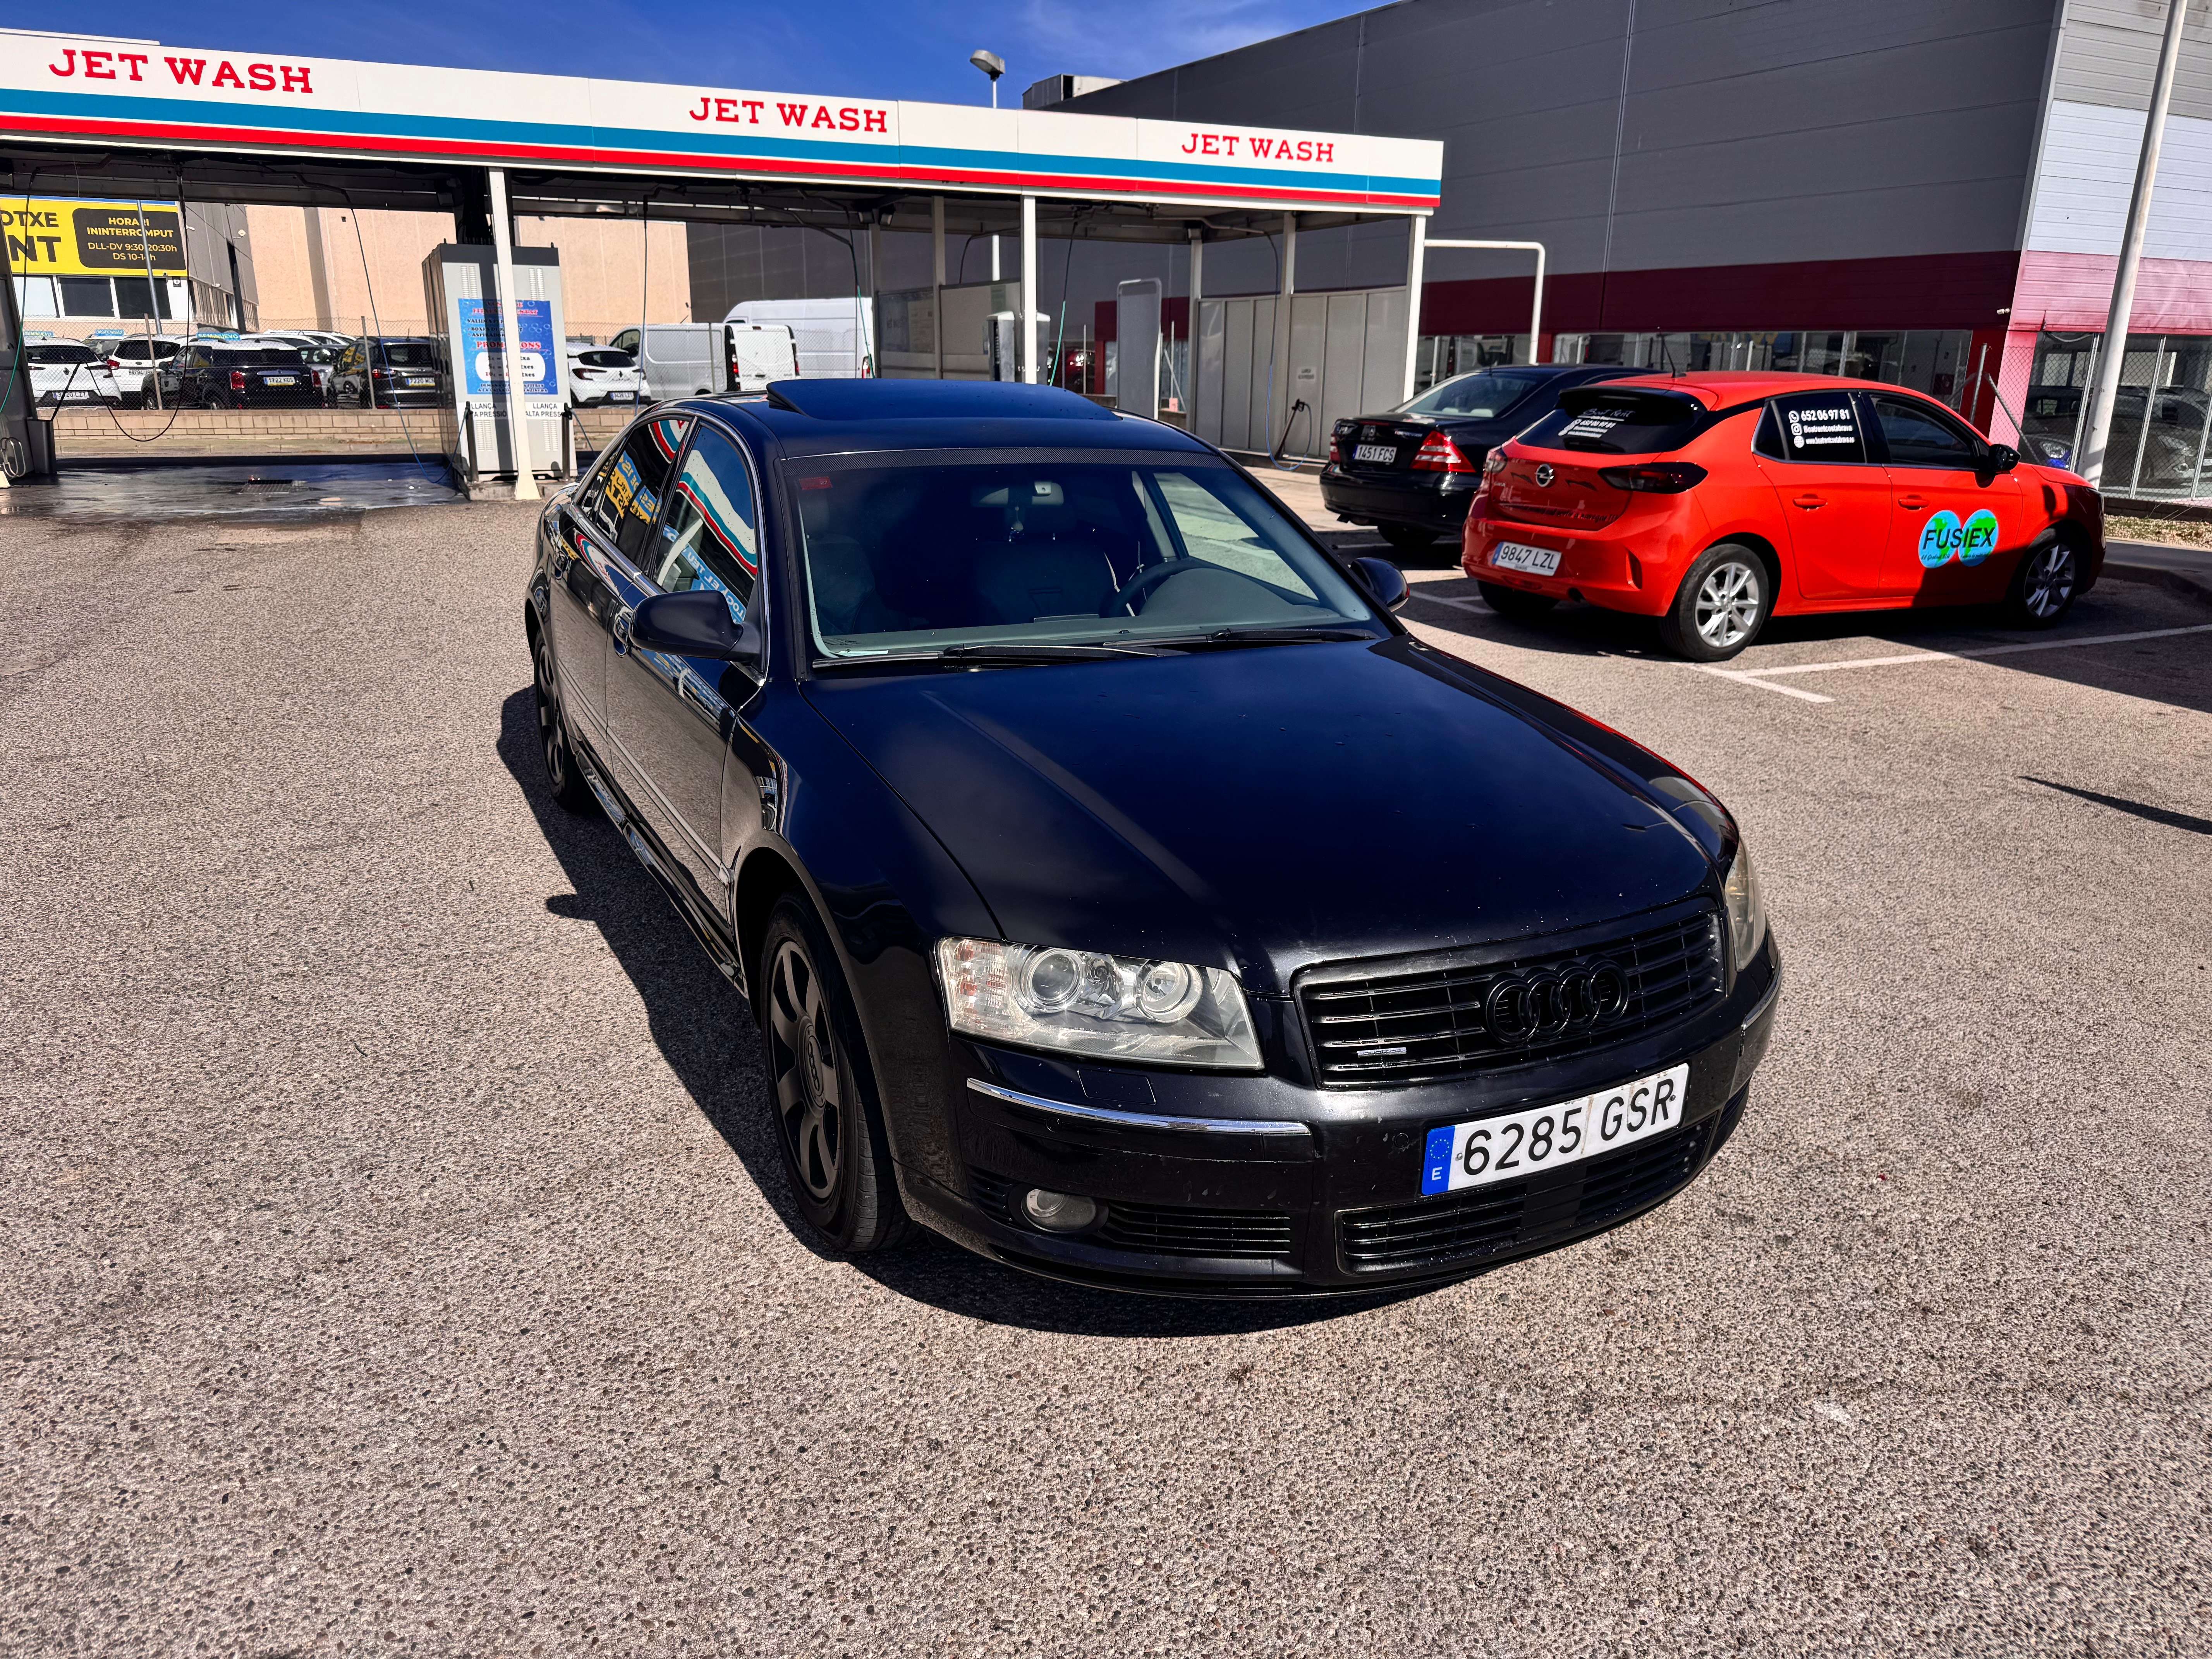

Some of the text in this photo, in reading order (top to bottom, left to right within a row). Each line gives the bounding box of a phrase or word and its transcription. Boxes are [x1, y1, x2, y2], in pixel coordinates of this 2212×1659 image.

[49, 49, 313, 93] JET WASH
[689, 97, 887, 133] JET WASH
[1182, 133, 1334, 163] JET WASH
[108, 217, 150, 226] HORAI
[1801, 409, 1850, 421] 652 06 97 81
[1358, 447, 1394, 461] 1451 FCS
[1922, 527, 1995, 550] FUSIEX
[1501, 546, 1555, 570] 9847 LZL
[1463, 1078, 1674, 1176] 6285 GSR
[1431, 1166, 1442, 1180] E
